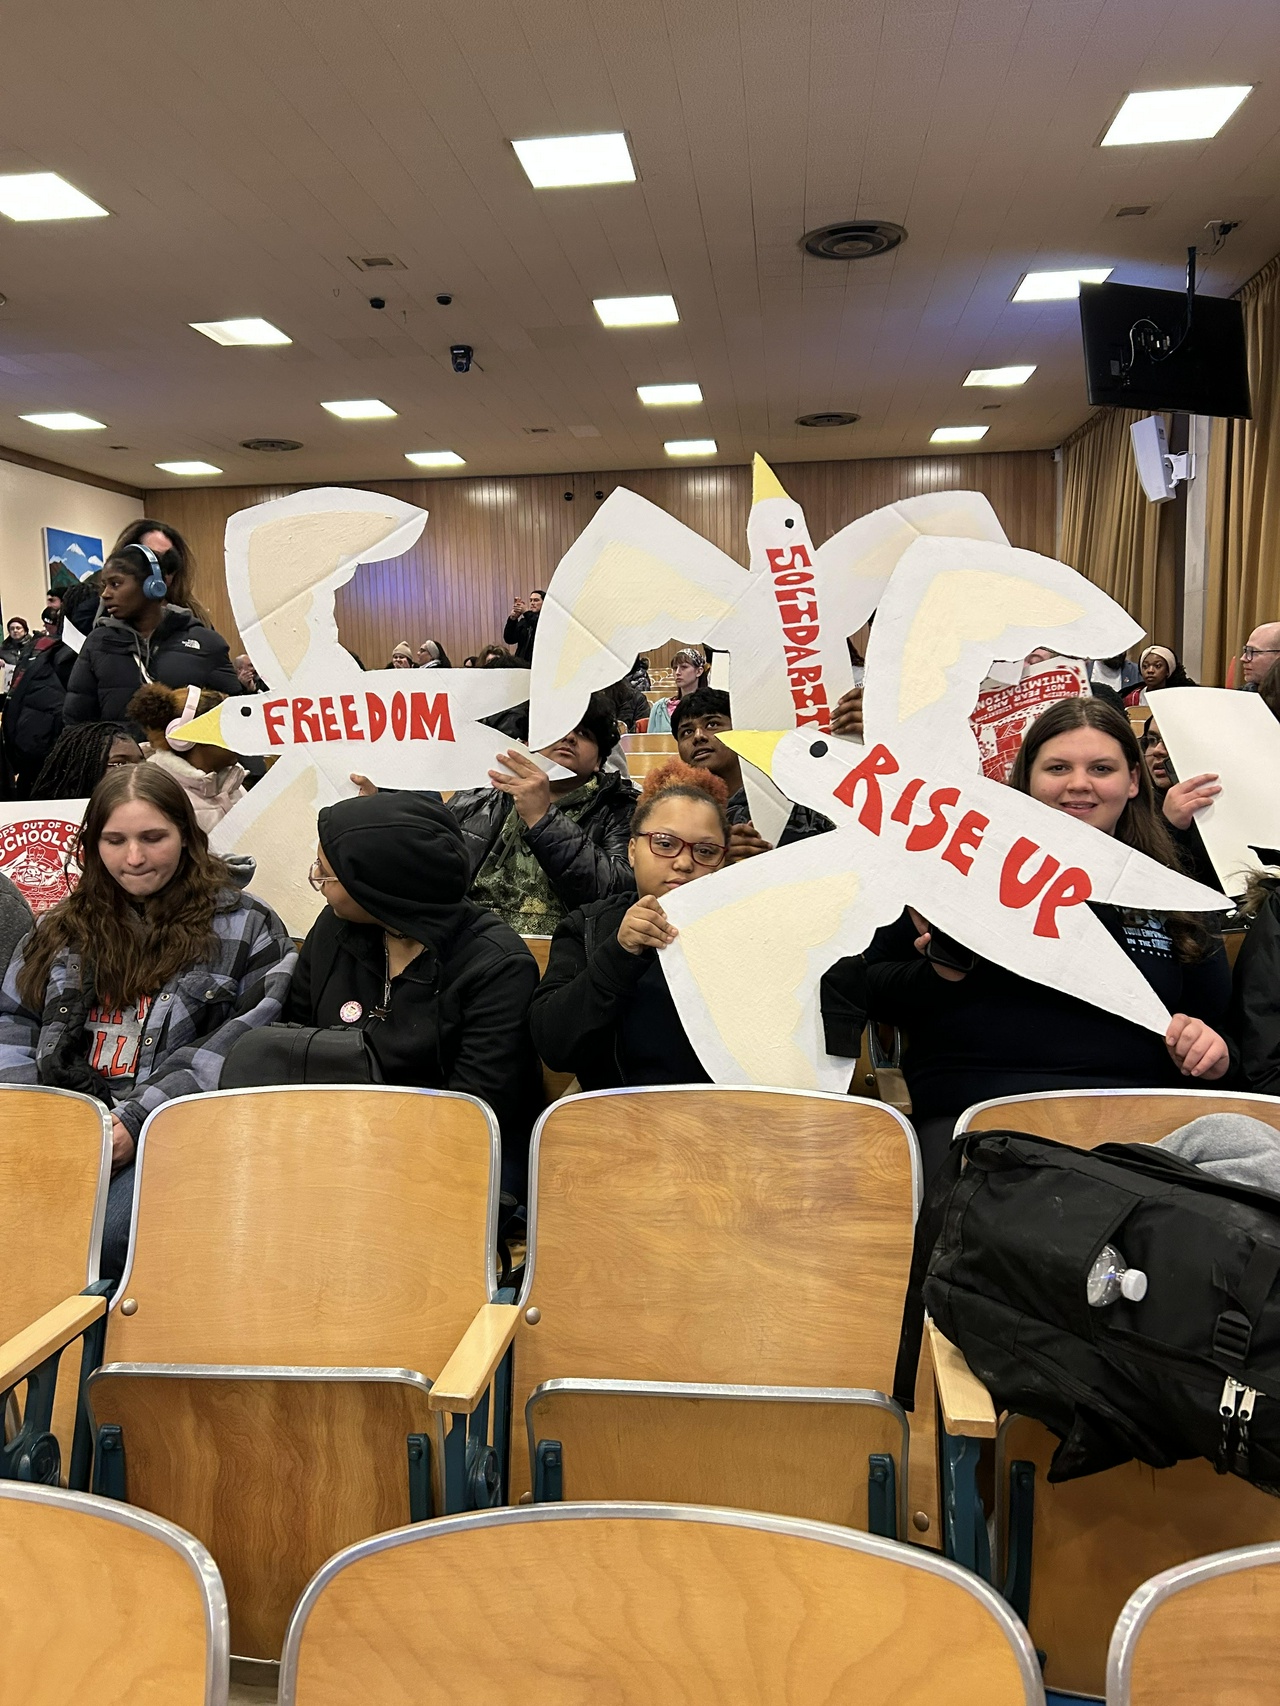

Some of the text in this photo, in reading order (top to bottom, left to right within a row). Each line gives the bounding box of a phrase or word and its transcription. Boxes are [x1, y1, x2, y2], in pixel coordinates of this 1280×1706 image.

[765, 545, 831, 736] SOLIDARIT
[263, 690, 456, 745] FREEDOM
[986, 684, 1066, 712] NOT FEAR AND
[22, 822, 45, 830] OUT
[47, 821, 62, 829] OF
[64, 822, 87, 834] OU
[833, 744, 1092, 939] RISE UP
